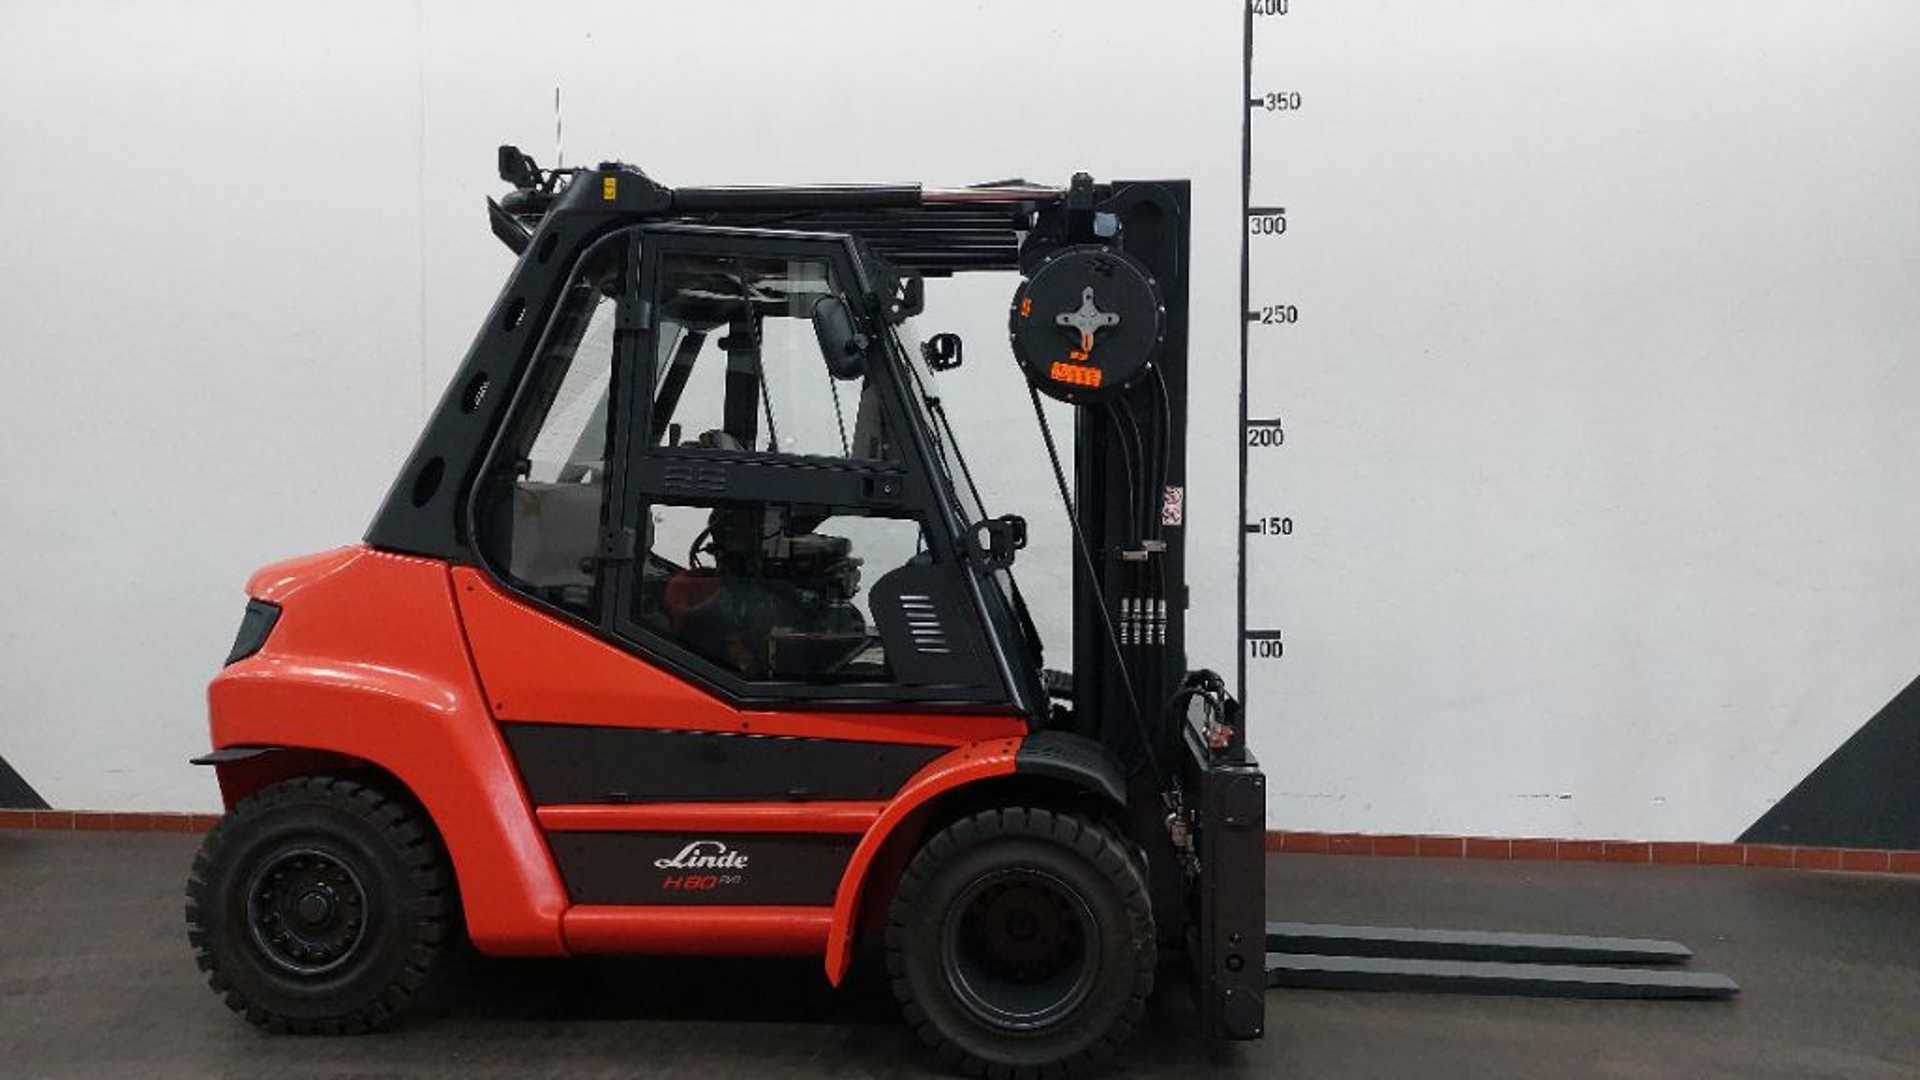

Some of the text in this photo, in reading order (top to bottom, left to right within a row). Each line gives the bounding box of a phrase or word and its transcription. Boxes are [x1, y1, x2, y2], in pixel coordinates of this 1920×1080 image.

[1253, 0, 1288, 15] 400
[1266, 92, 1301, 111] 350
[1251, 217, 1286, 234] 300
[1262, 305, 1298, 324] 250
[1248, 428, 1284, 446] 200
[1260, 517, 1293, 535] 150
[1251, 641, 1283, 658] 100
[654, 841, 748, 868] Linde
